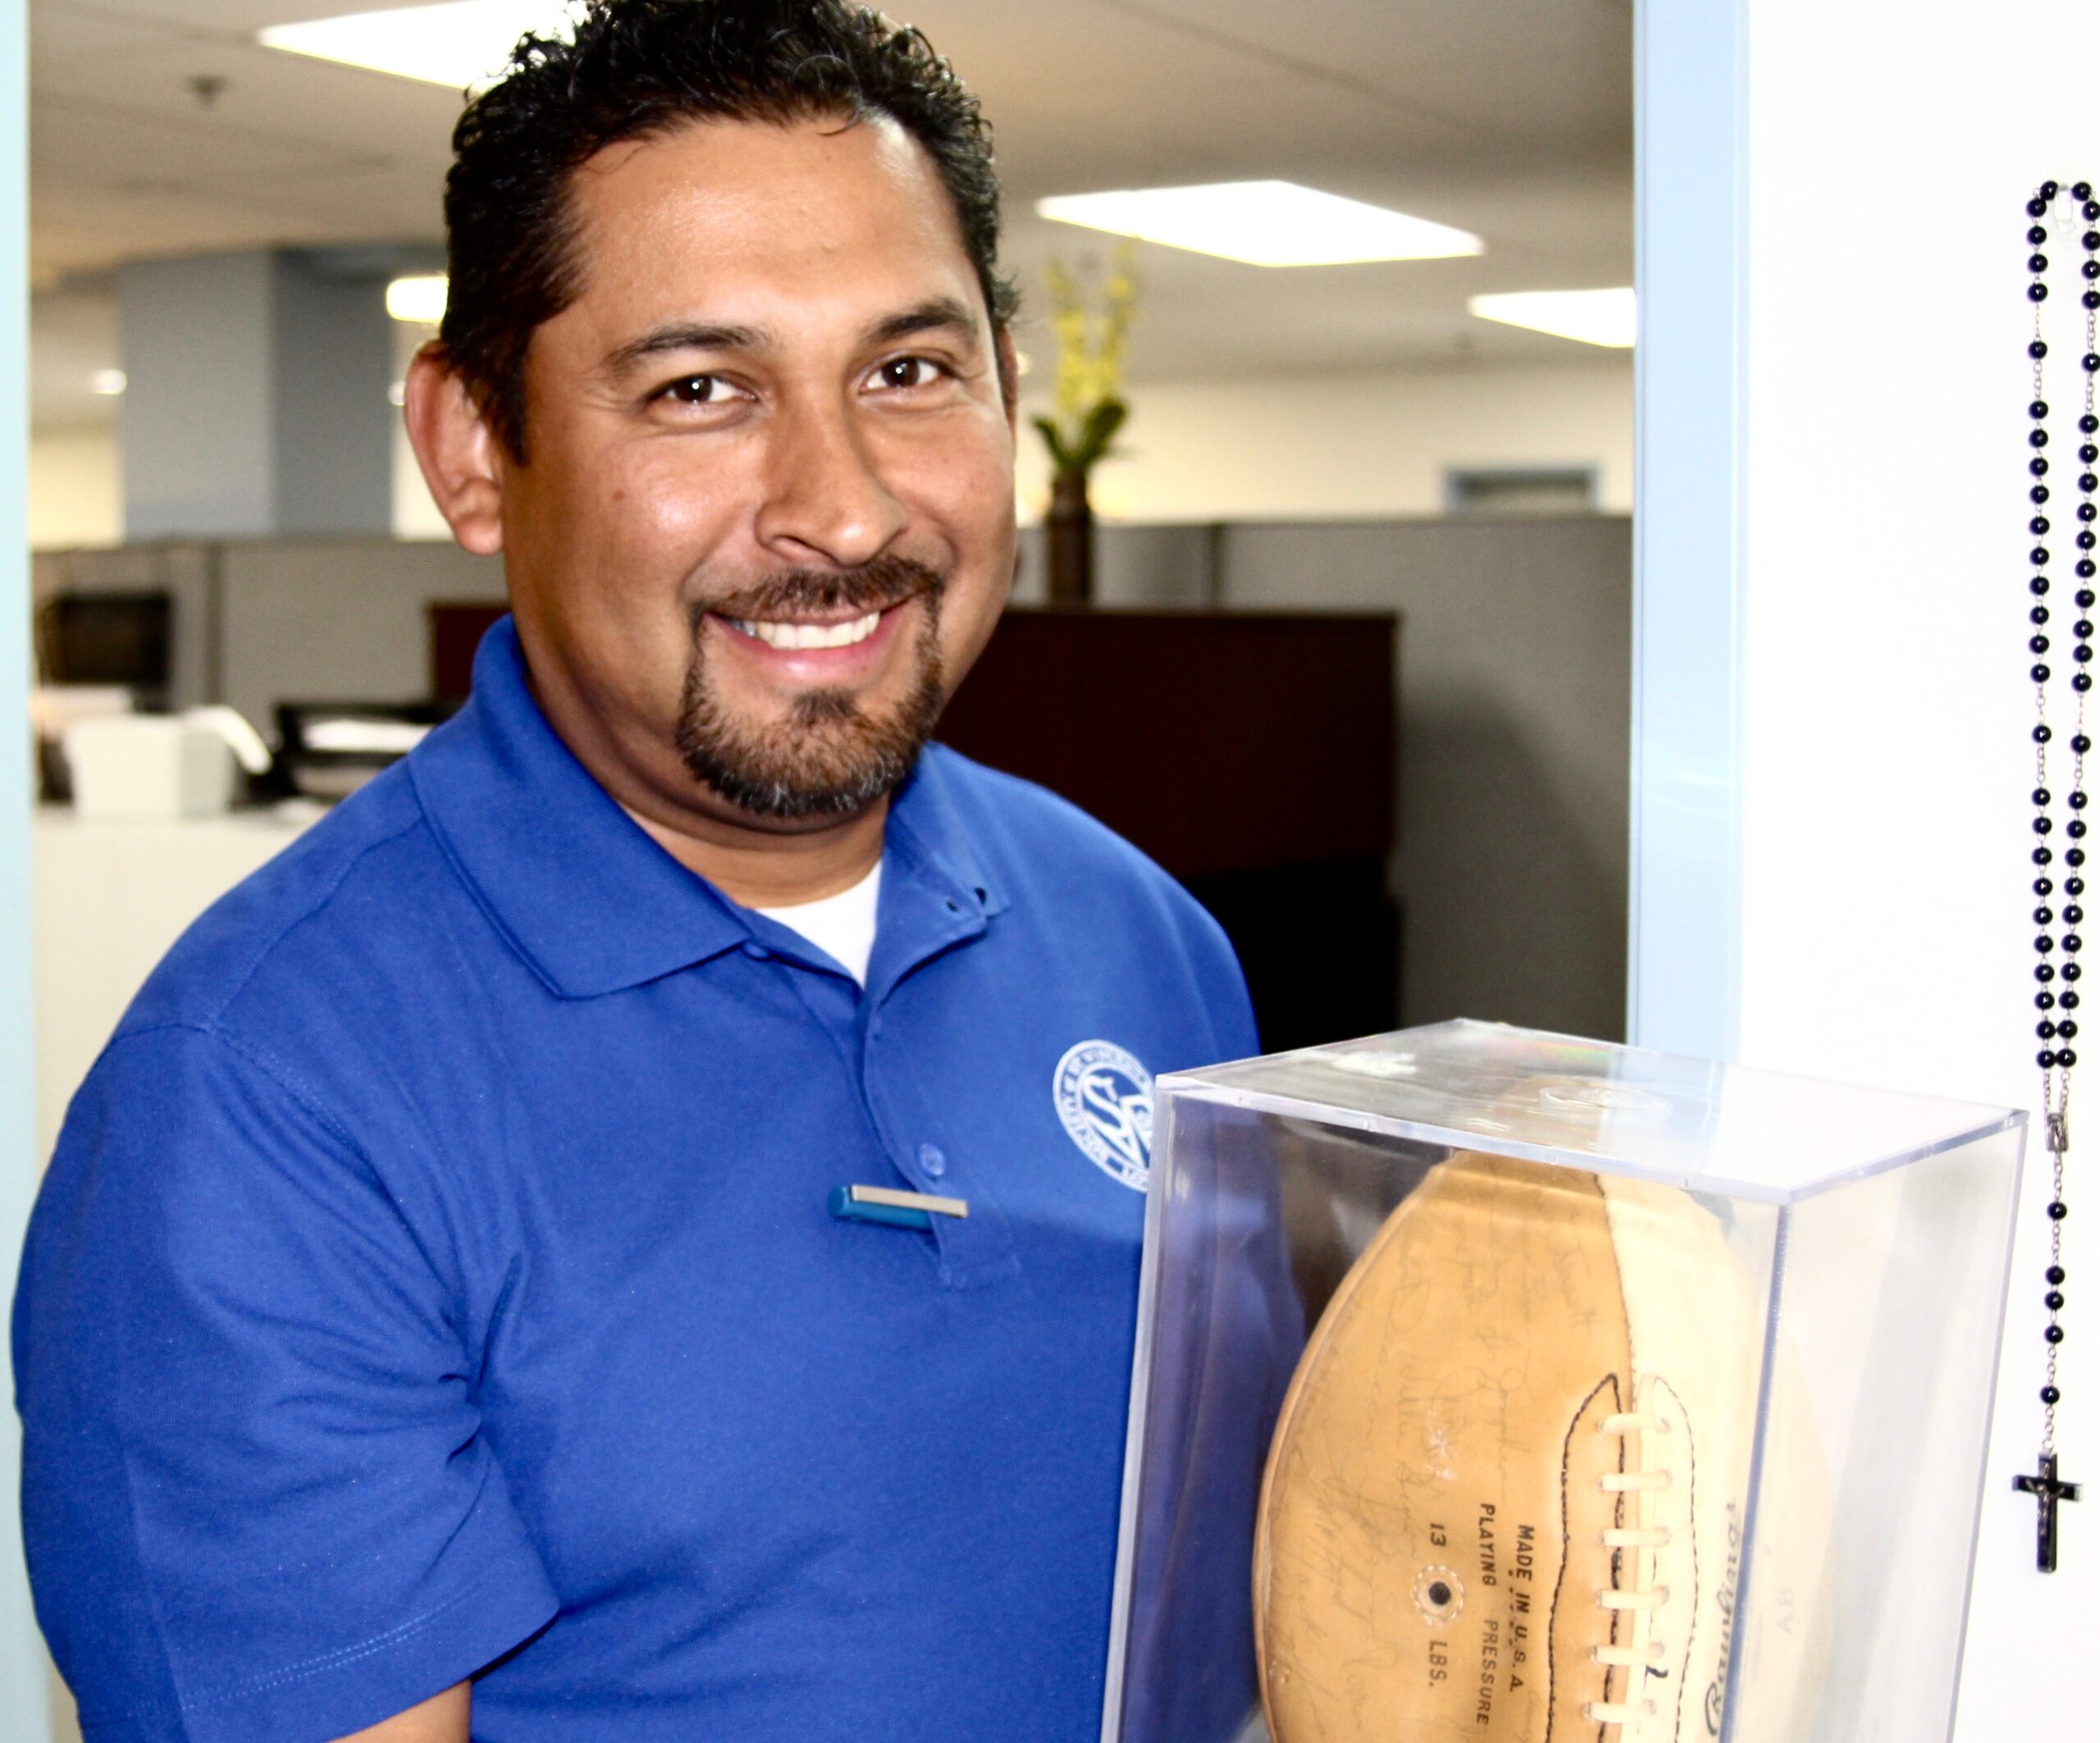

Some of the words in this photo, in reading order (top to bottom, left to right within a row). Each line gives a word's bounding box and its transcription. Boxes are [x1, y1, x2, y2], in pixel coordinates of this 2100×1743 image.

[1429, 1522, 1447, 1548] 13
[1477, 1503, 1497, 1586] PLAYING
[1515, 1524, 1535, 1582] MADE
[1515, 1592, 1531, 1614] IN
[1428, 1640, 1448, 1688] LBS.
[1476, 1619, 1499, 1726] PRESSURE
